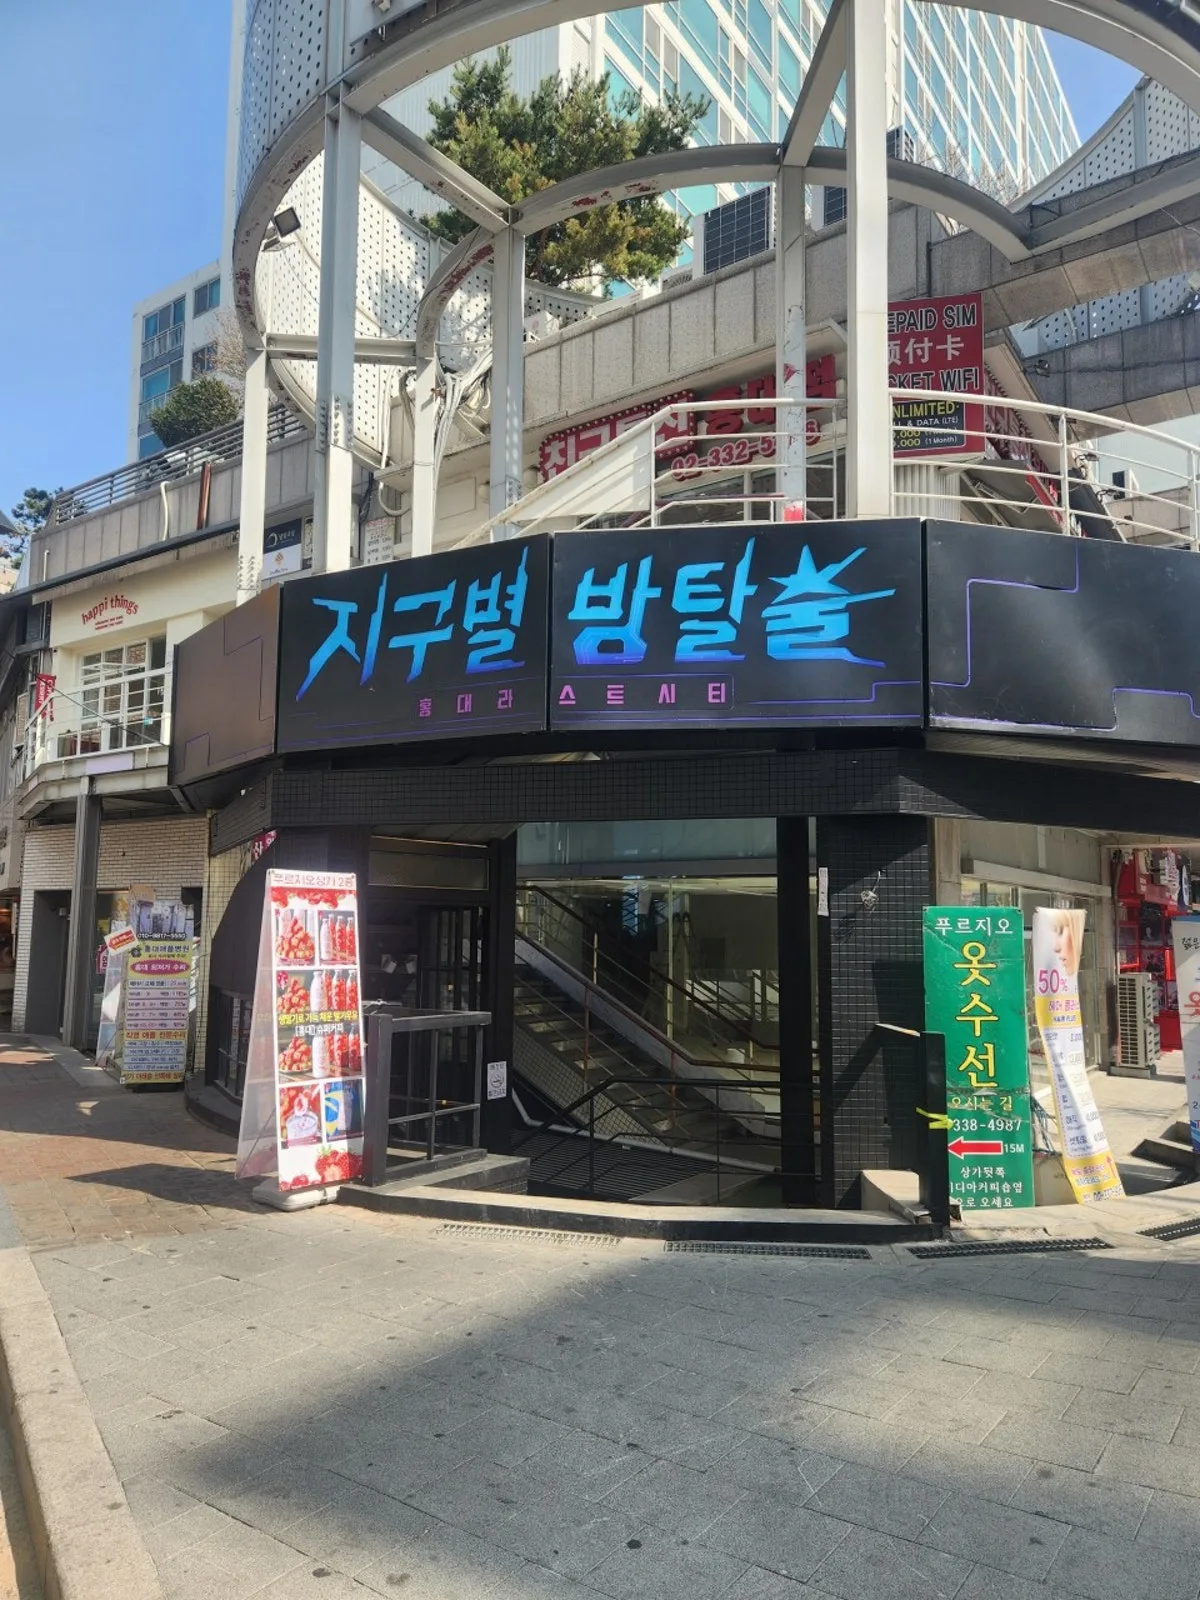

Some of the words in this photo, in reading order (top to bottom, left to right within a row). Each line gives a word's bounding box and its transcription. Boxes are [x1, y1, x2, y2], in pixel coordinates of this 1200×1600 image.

[942, 303, 977, 330] SIM
[940, 367, 979, 391] WIFI
[916, 418, 940, 427] DATA
[942, 416, 959, 425] (LTE)
[81, 597, 108, 625] happi
[110, 594, 139, 615] things
[296, 546, 528, 700] 지구별
[566, 536, 896, 668] 방탈출
[934, 916, 1014, 936] 푸르지오
[1038, 969, 1068, 994] 50%
[953, 941, 999, 1088] 옷수선
[953, 1118, 1022, 1132] 338-4987
[1004, 1143, 1025, 1153] 15M
[980, 1197, 1014, 1208] 오세요
